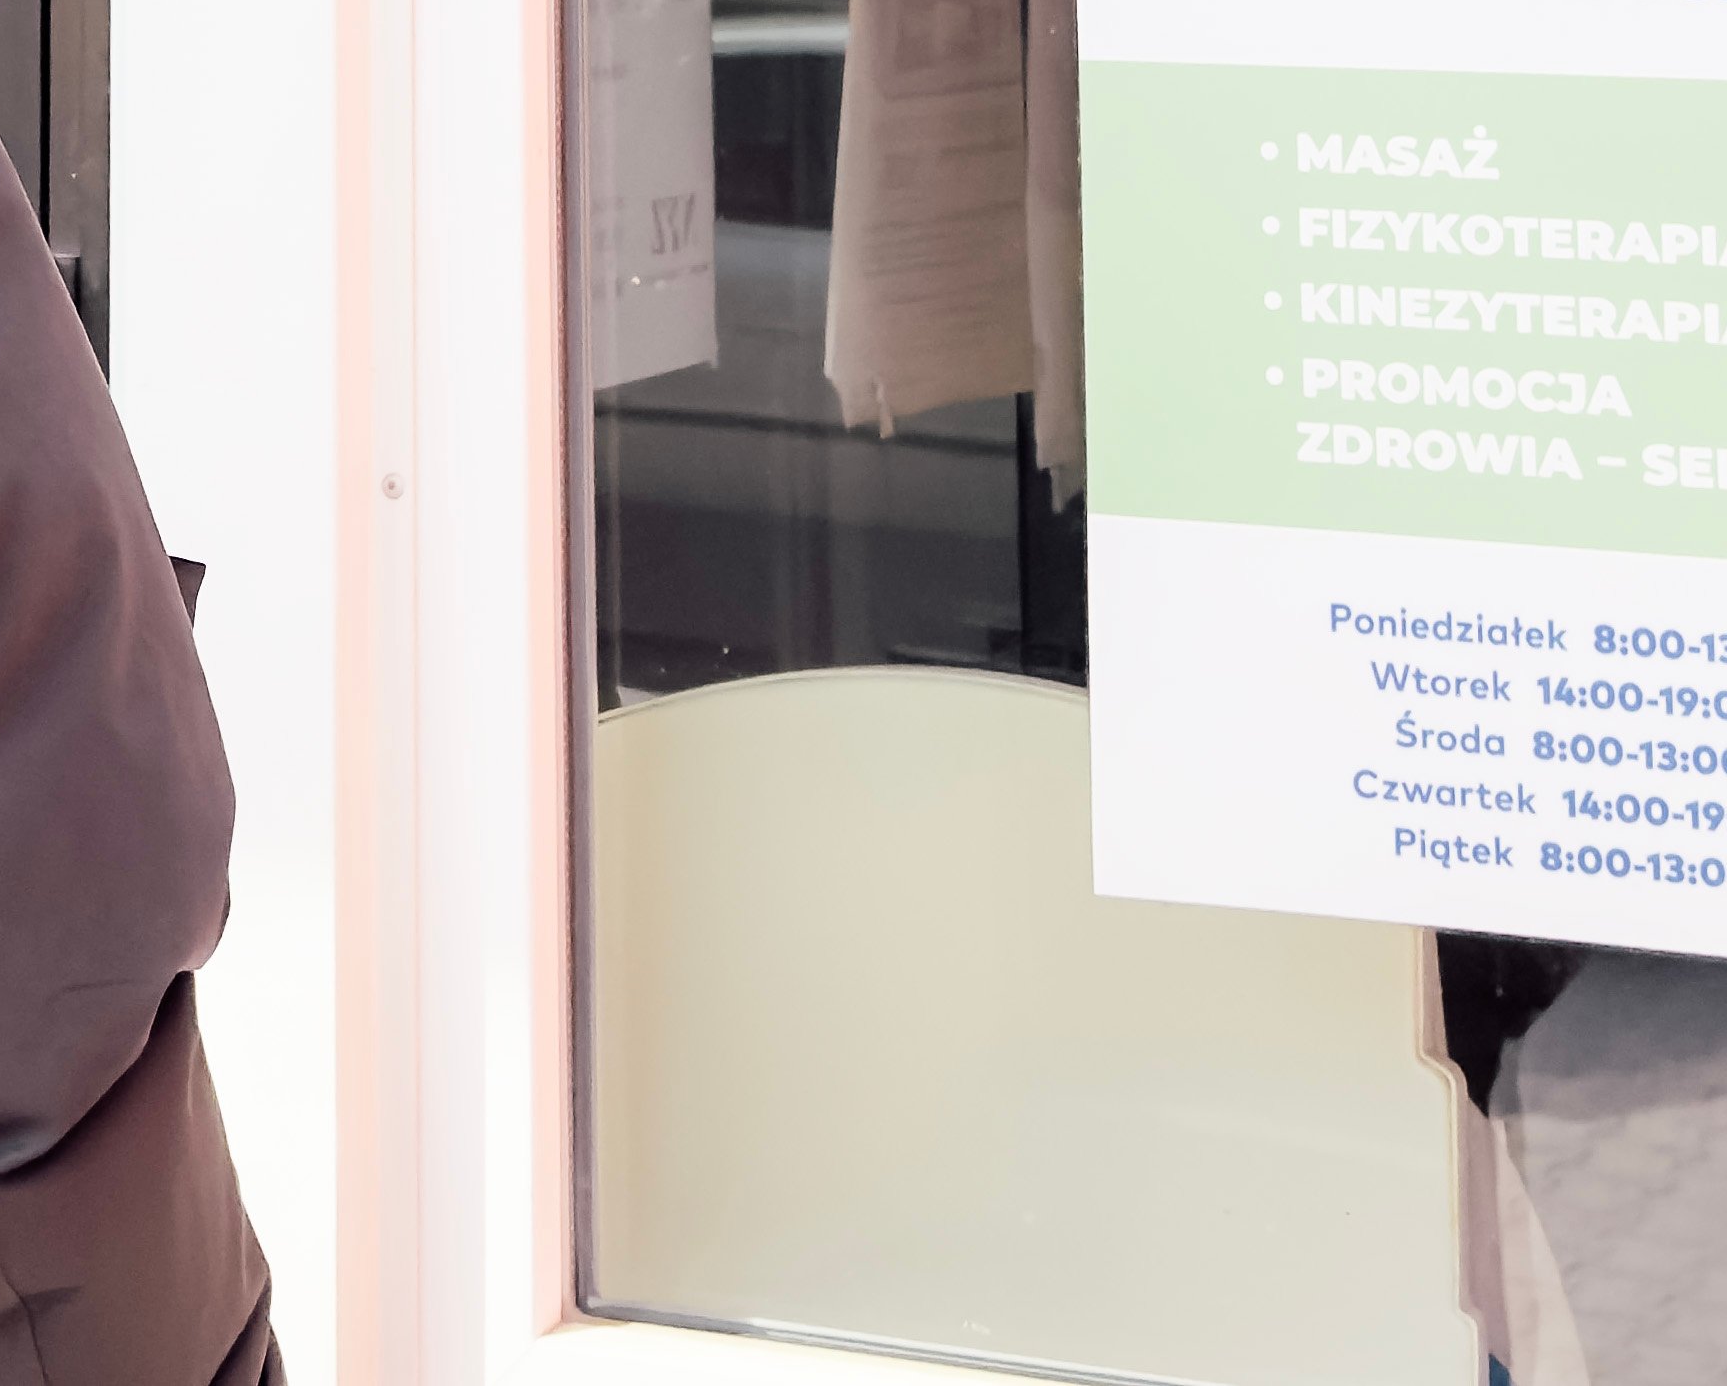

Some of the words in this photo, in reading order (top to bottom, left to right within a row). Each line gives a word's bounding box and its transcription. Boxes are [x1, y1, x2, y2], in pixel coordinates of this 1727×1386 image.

[1296, 124, 1501, 181] MASAŻ
[1302, 357, 1633, 418] PROMOCJA
[1295, 420, 1584, 481] ZDROWIA
[1330, 603, 1566, 651] Poniedziałek
[1371, 661, 1510, 701] Wtorek
[1395, 710, 1505, 756] Środa
[1353, 769, 1536, 814] Czwartek
[1394, 827, 1513, 869] Piątek
